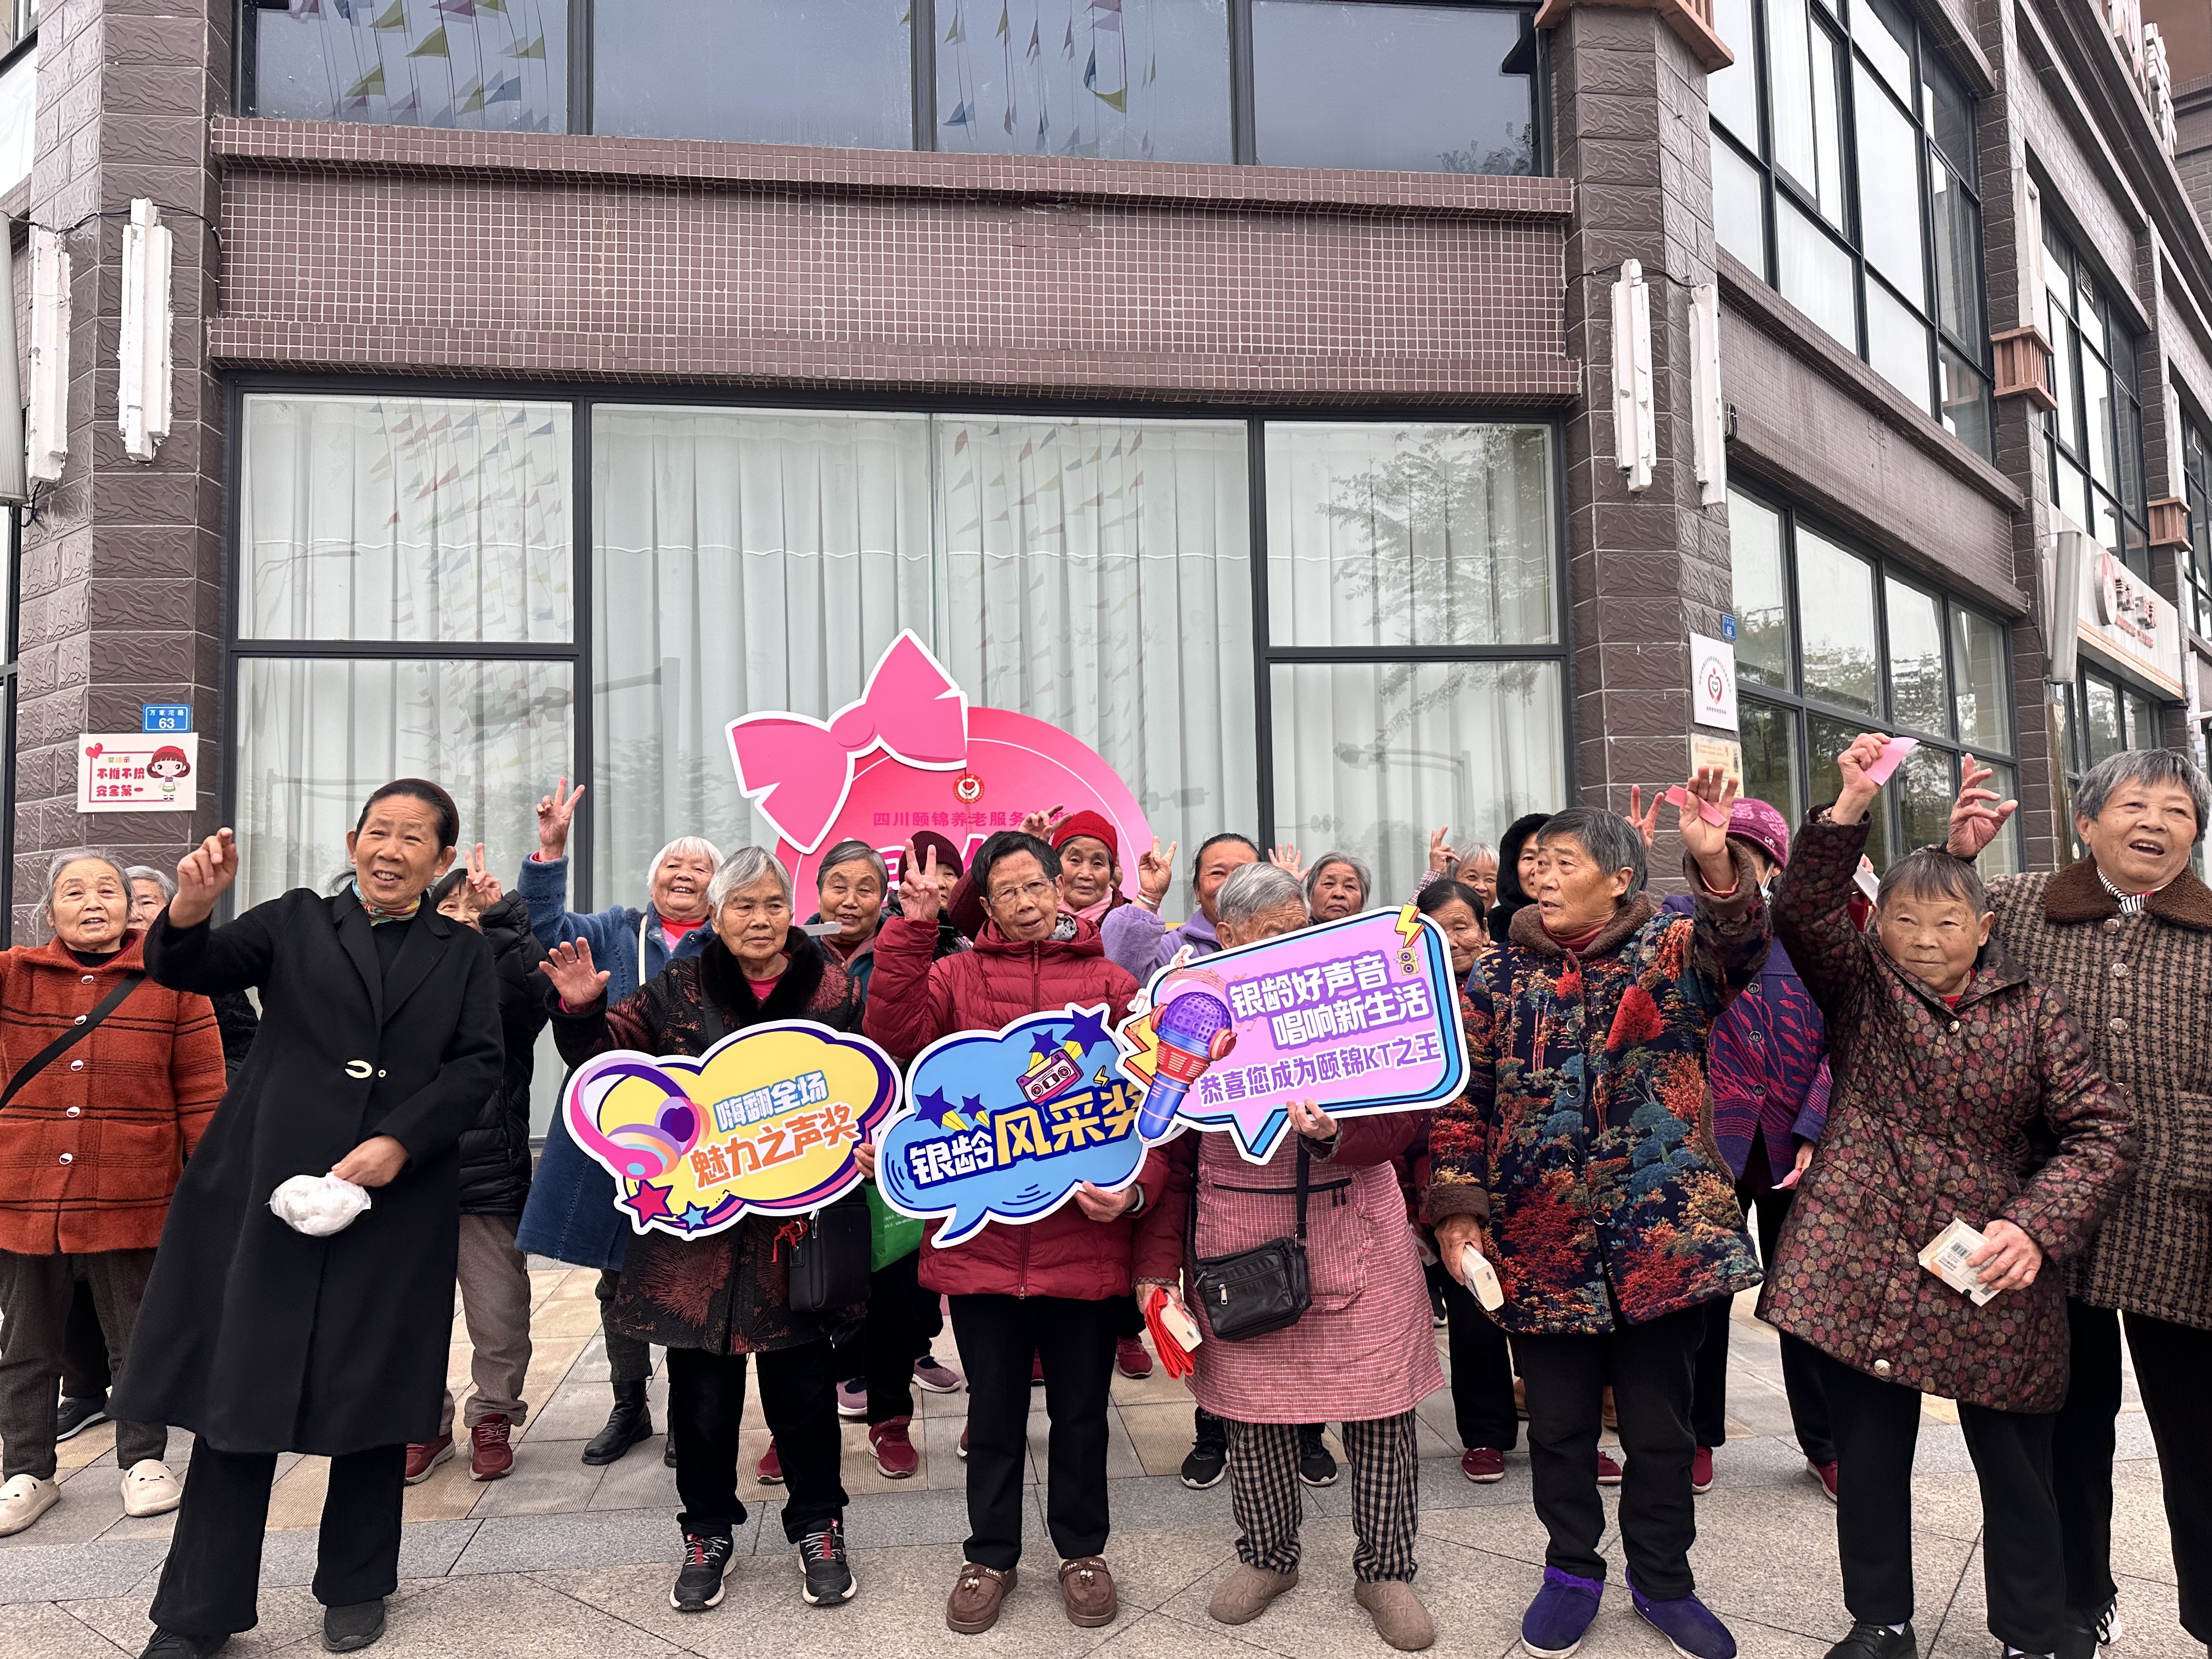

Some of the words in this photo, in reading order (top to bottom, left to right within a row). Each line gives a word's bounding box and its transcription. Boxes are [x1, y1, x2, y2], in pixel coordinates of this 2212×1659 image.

[159, 718, 175, 729] 63
[96, 785, 144, 797] 安全第一
[873, 811, 1065, 827] 四川颐锦养老服务
[1228, 955, 1386, 1019] 银龄好声音
[1272, 983, 1430, 1046] 唱响新生活
[1200, 1031, 1442, 1105] 恭喜您成为颐锦KT之王
[715, 1072, 828, 1131] 嗨翻全场
[690, 1103, 859, 1188] 魅力之声奖
[909, 1082, 1145, 1185] 银龄风采奖
